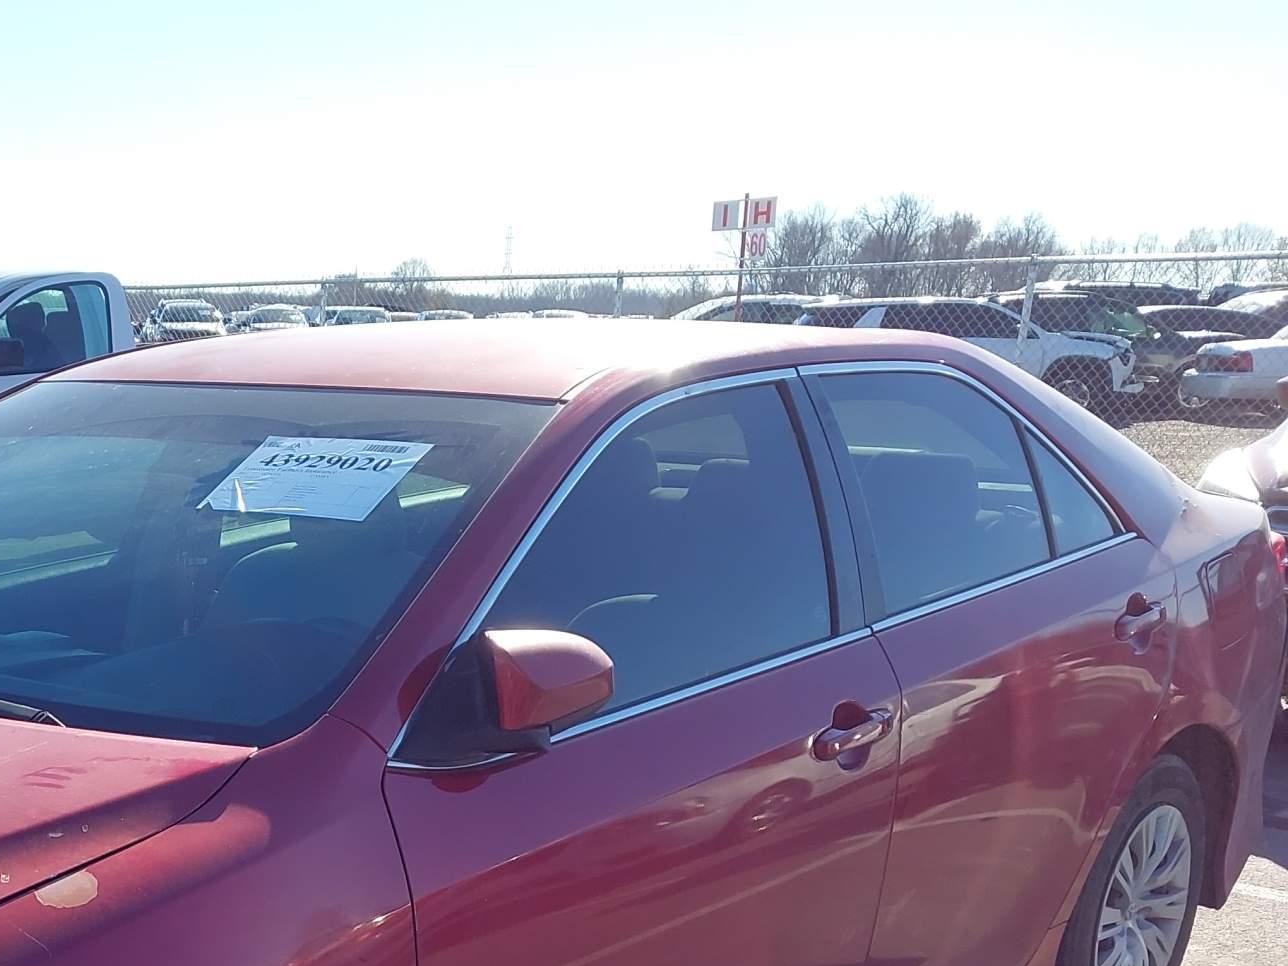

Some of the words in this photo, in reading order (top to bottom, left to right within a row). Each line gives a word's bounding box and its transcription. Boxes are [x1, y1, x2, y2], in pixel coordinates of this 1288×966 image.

[753, 200, 772, 225] H
[750, 232, 767, 257] 60
[260, 452, 393, 473] 43929020
